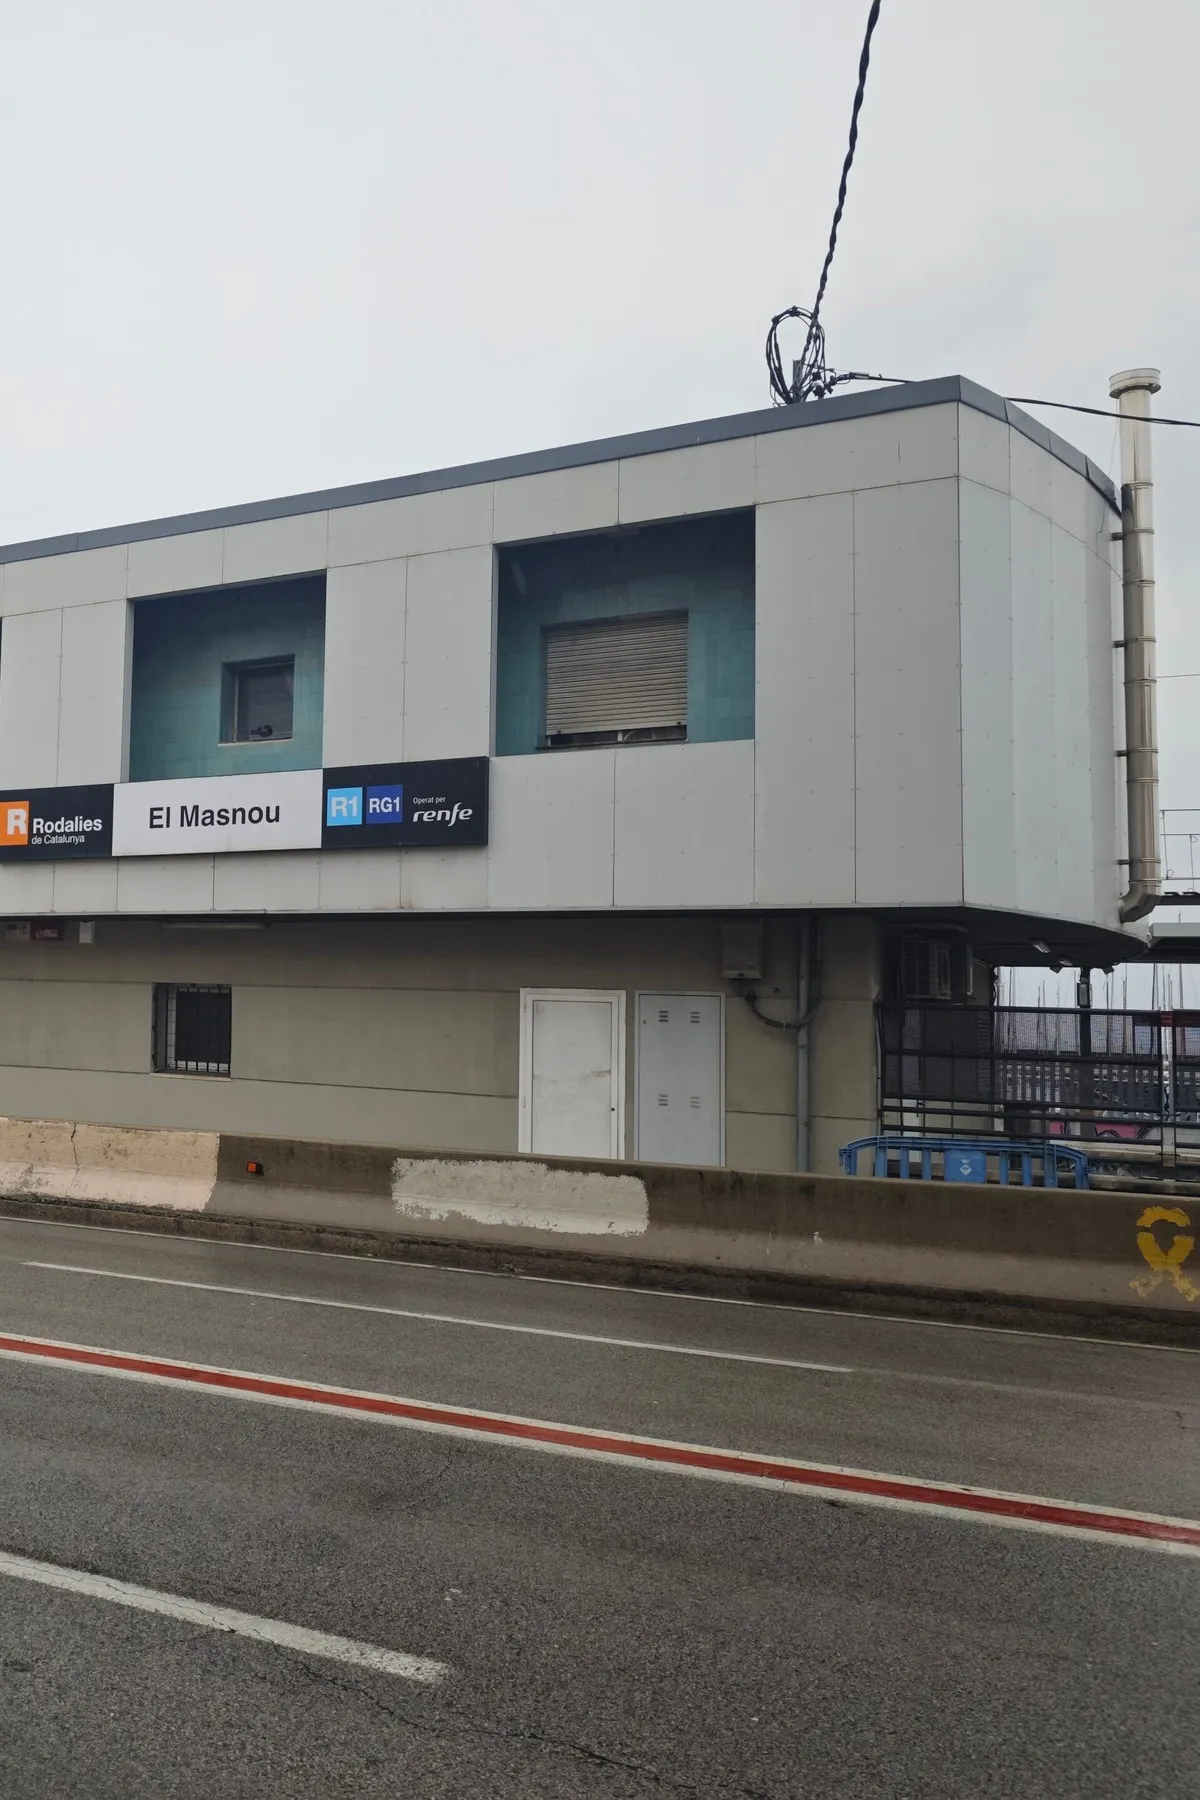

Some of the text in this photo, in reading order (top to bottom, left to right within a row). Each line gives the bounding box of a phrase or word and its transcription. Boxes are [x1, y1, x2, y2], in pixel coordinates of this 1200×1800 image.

[331, 796, 400, 818] R1 RG1
[412, 796, 446, 805] Operat per
[6, 808, 28, 836] R
[32, 815, 103, 834] Rodalies
[149, 804, 280, 829] El Masnou
[412, 802, 473, 827] renfe
[31, 834, 85, 845] de Catalunya
